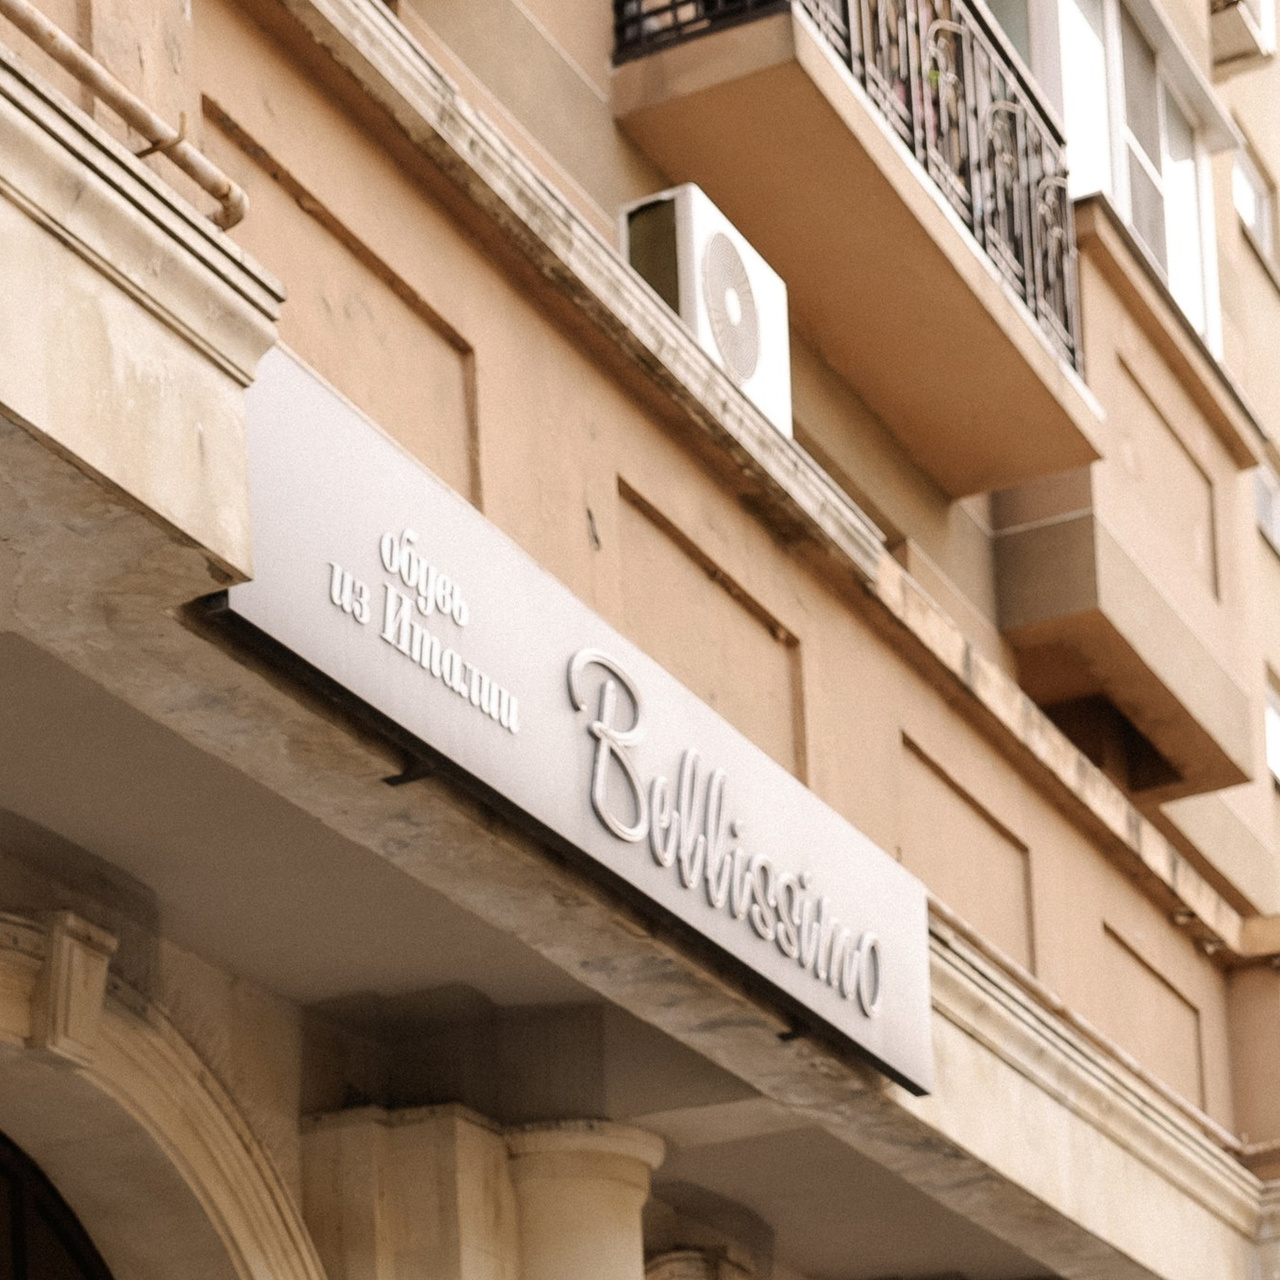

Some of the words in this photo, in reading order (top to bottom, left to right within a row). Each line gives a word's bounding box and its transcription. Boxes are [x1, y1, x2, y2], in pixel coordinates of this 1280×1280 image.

[328, 562, 371, 625] из
[380, 583, 520, 734] Италии
[380, 529, 470, 627] обувь
[568, 647, 882, 1017] Bellissimo
